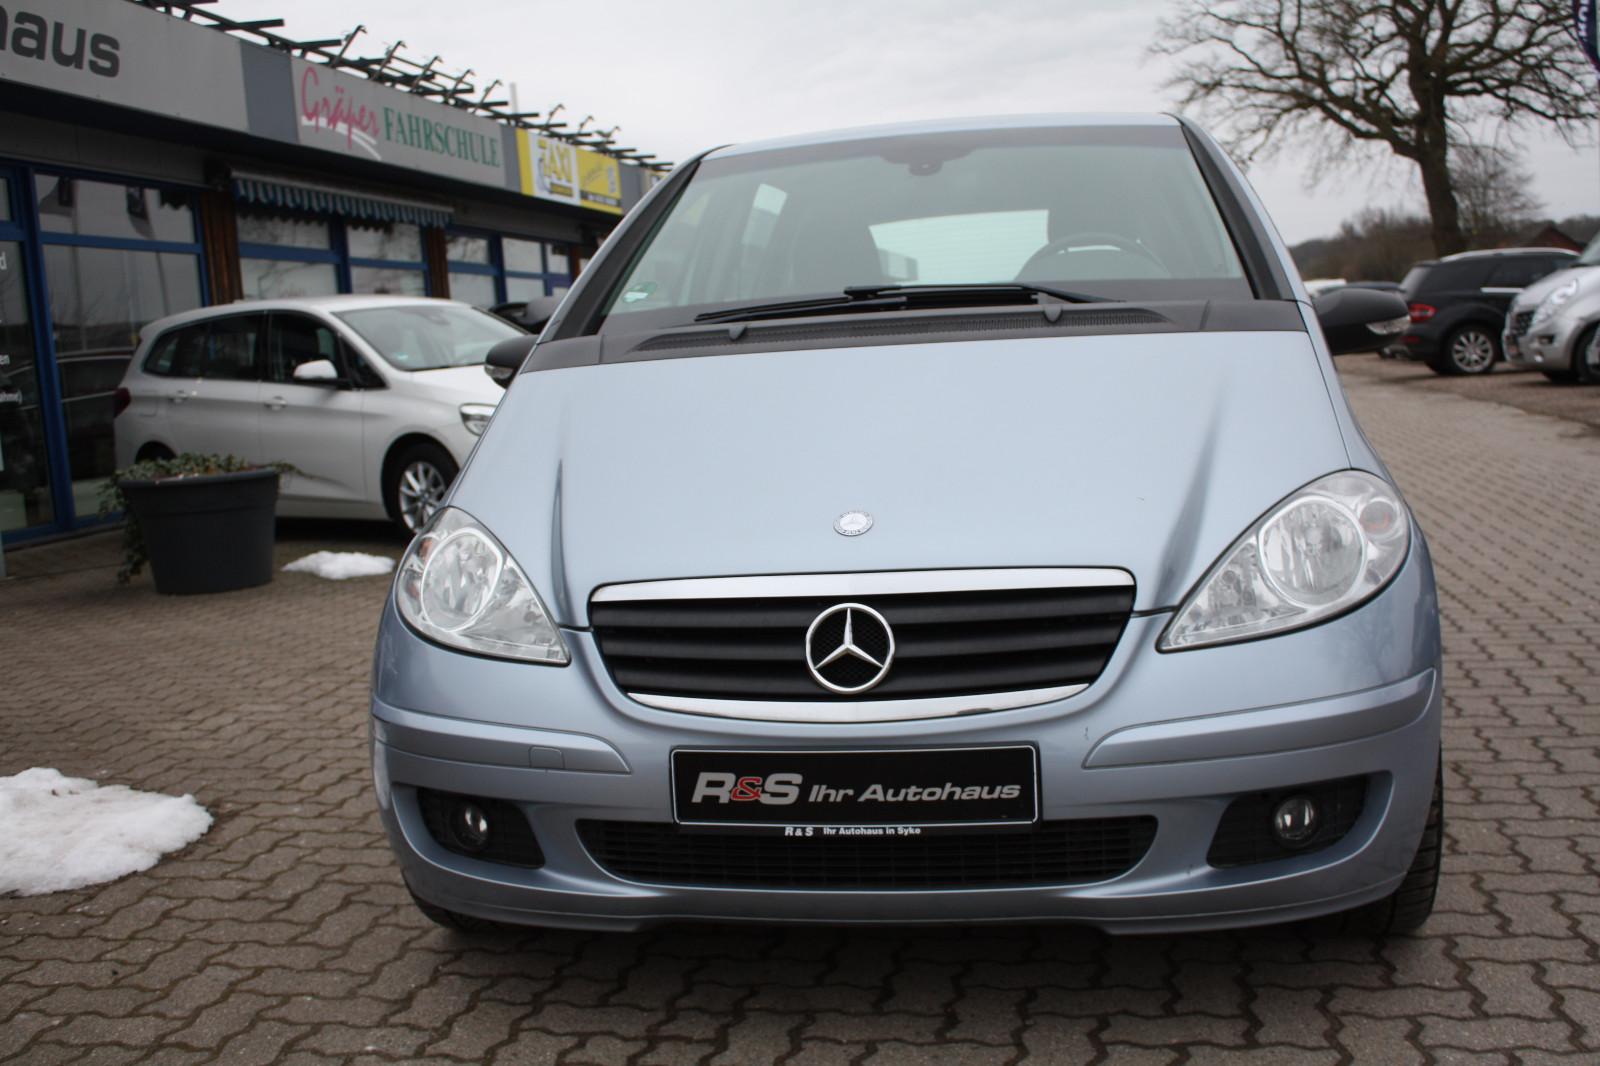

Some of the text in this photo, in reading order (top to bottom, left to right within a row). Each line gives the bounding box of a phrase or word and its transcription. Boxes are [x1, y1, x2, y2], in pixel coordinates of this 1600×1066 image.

[383, 106, 502, 168] FAHRSCHULE
[691, 772, 1021, 805] R&S Ihr Autohaus
[823, 826, 837, 836] Ihr
[838, 826, 884, 836] Autohaus
[886, 826, 896, 835] in
[897, 826, 921, 836] Syke
